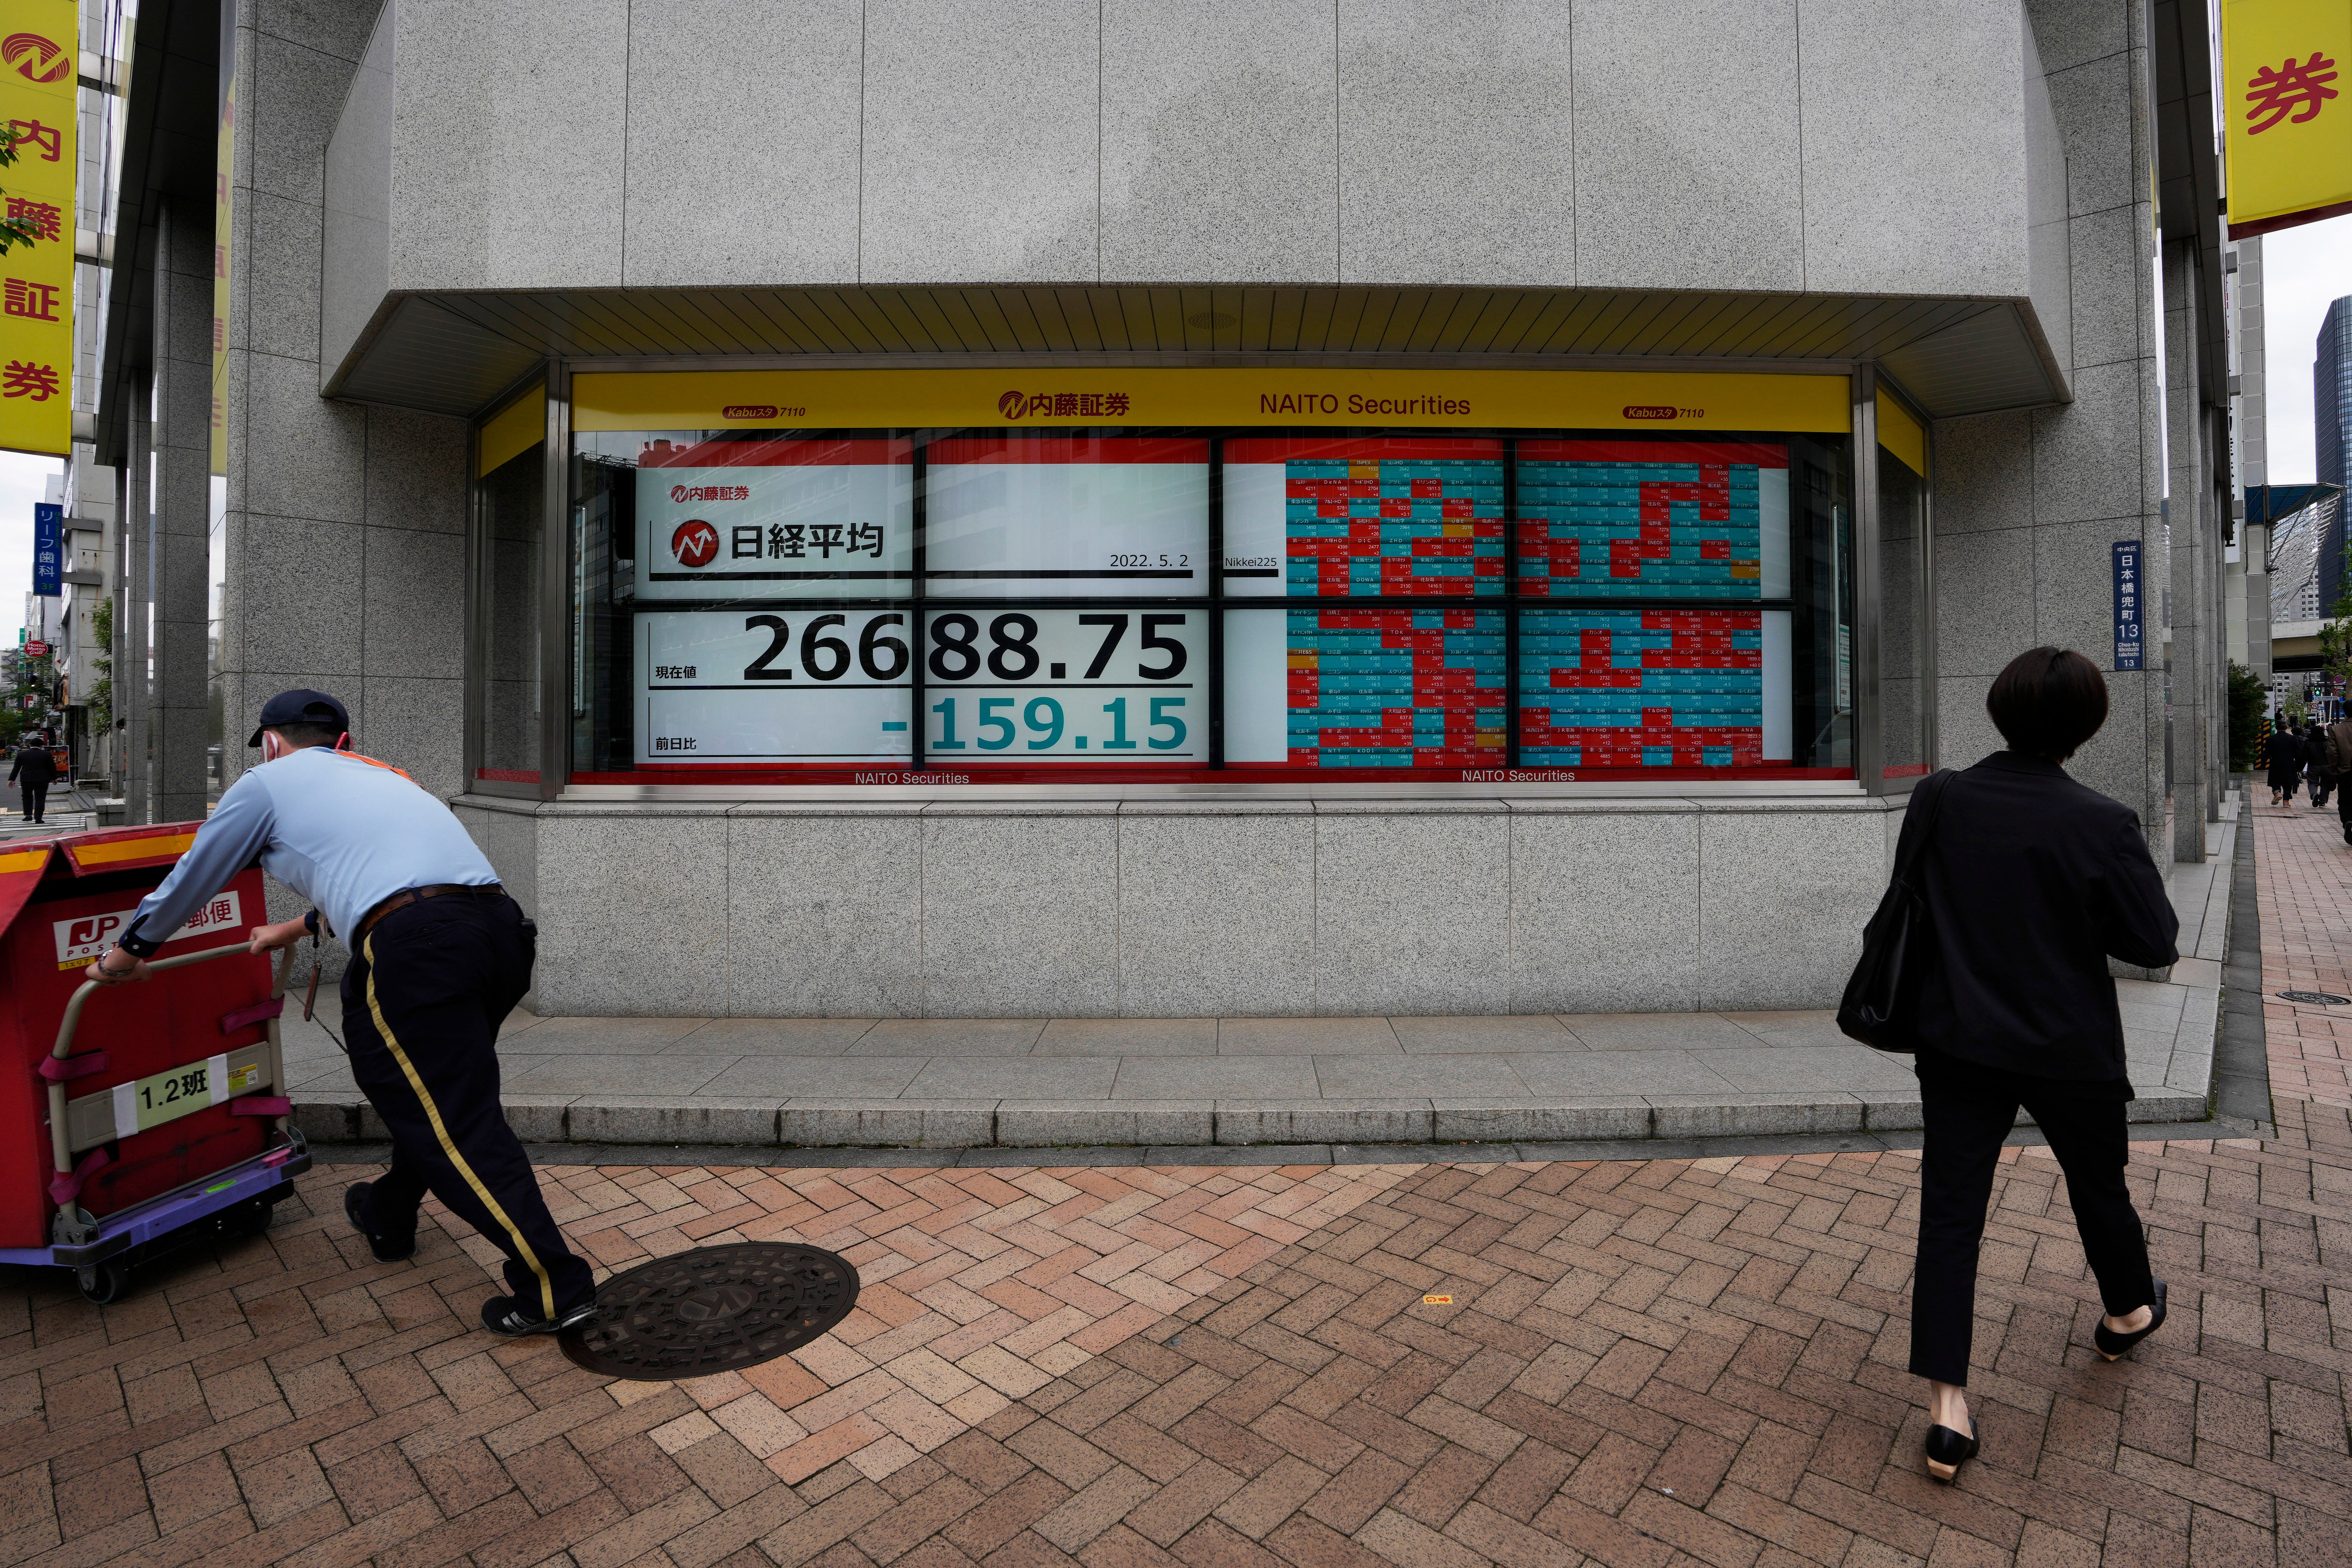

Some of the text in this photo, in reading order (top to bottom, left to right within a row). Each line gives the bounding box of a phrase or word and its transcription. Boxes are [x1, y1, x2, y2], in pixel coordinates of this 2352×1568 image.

[2246, 51, 2339, 136] 券
[728, 407, 805, 417] Kabuスタ 7110
[1029, 392, 1130, 417] 内藤証券
[1260, 393, 1471, 416] NAITO Securities
[1679, 409, 1704, 418] 7110
[689, 486, 749, 501] 内藤証券
[38, 510, 55, 577] リーフ歯科
[731, 522, 884, 559] 日経平均
[1225, 556, 1277, 567] Nikkei225
[2120, 555, 2134, 621] 日本橋兜町
[2118, 624, 2139, 638] 13
[743, 613, 1188, 681] 26688.75
[655, 665, 697, 679] 現在値
[655, 737, 697, 751] 前日比
[855, 772, 969, 785] NAITO Securities
[1462, 770, 1575, 781] NAITO Securities
[182, 899, 233, 929] 郵便
[68, 915, 120, 948] JP
[140, 1069, 208, 1110] 1.2班
